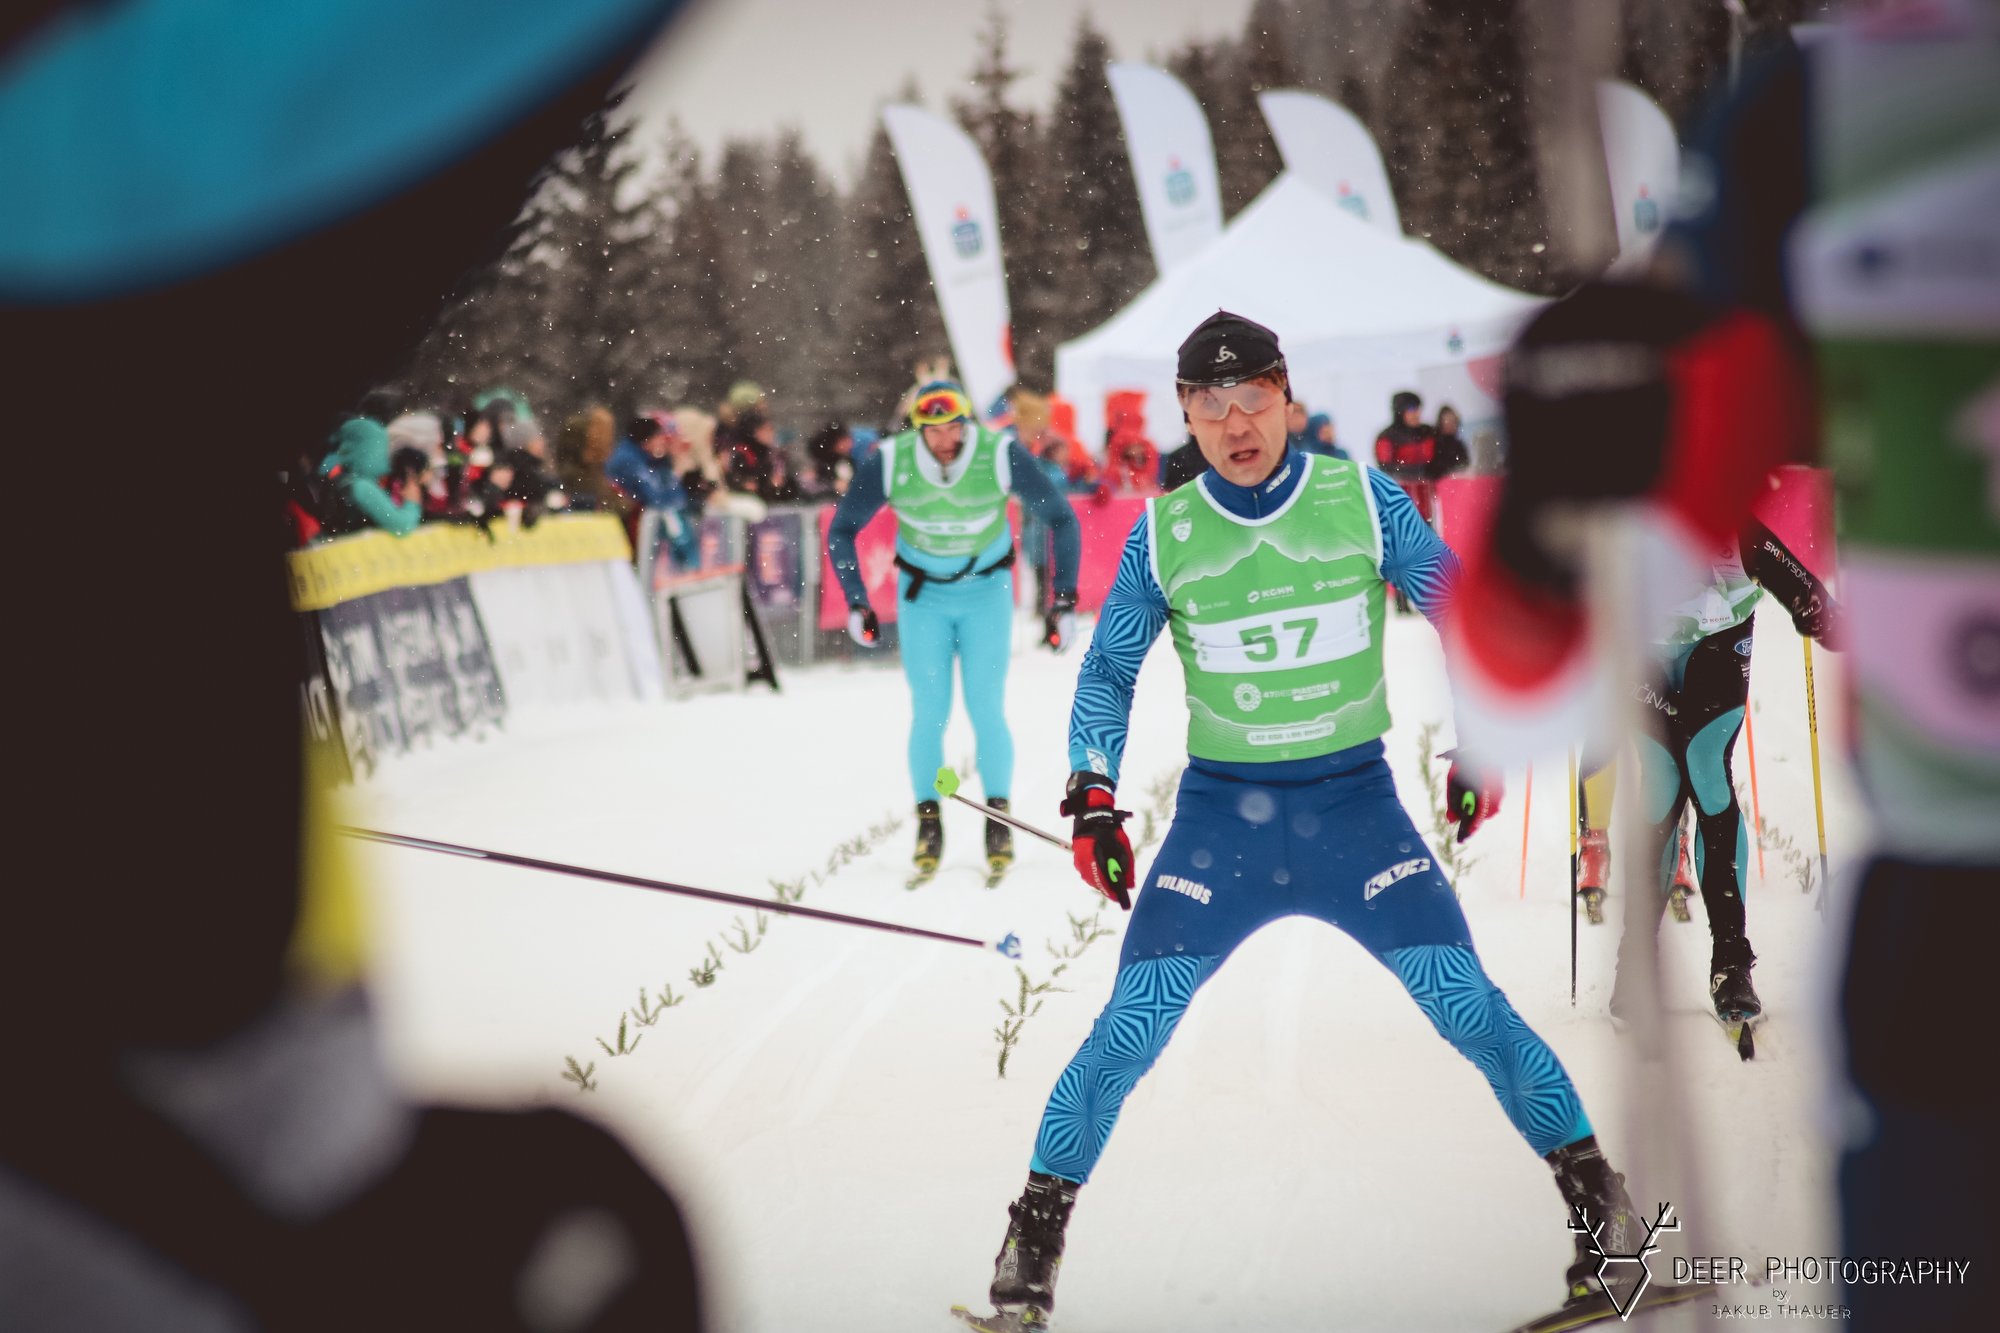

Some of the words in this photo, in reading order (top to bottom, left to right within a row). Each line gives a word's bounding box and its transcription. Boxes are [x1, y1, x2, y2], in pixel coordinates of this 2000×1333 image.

[1262, 585, 1295, 598] KGHM
[1238, 617, 1318, 663] 57
[1156, 874, 1213, 905] VILNIUS
